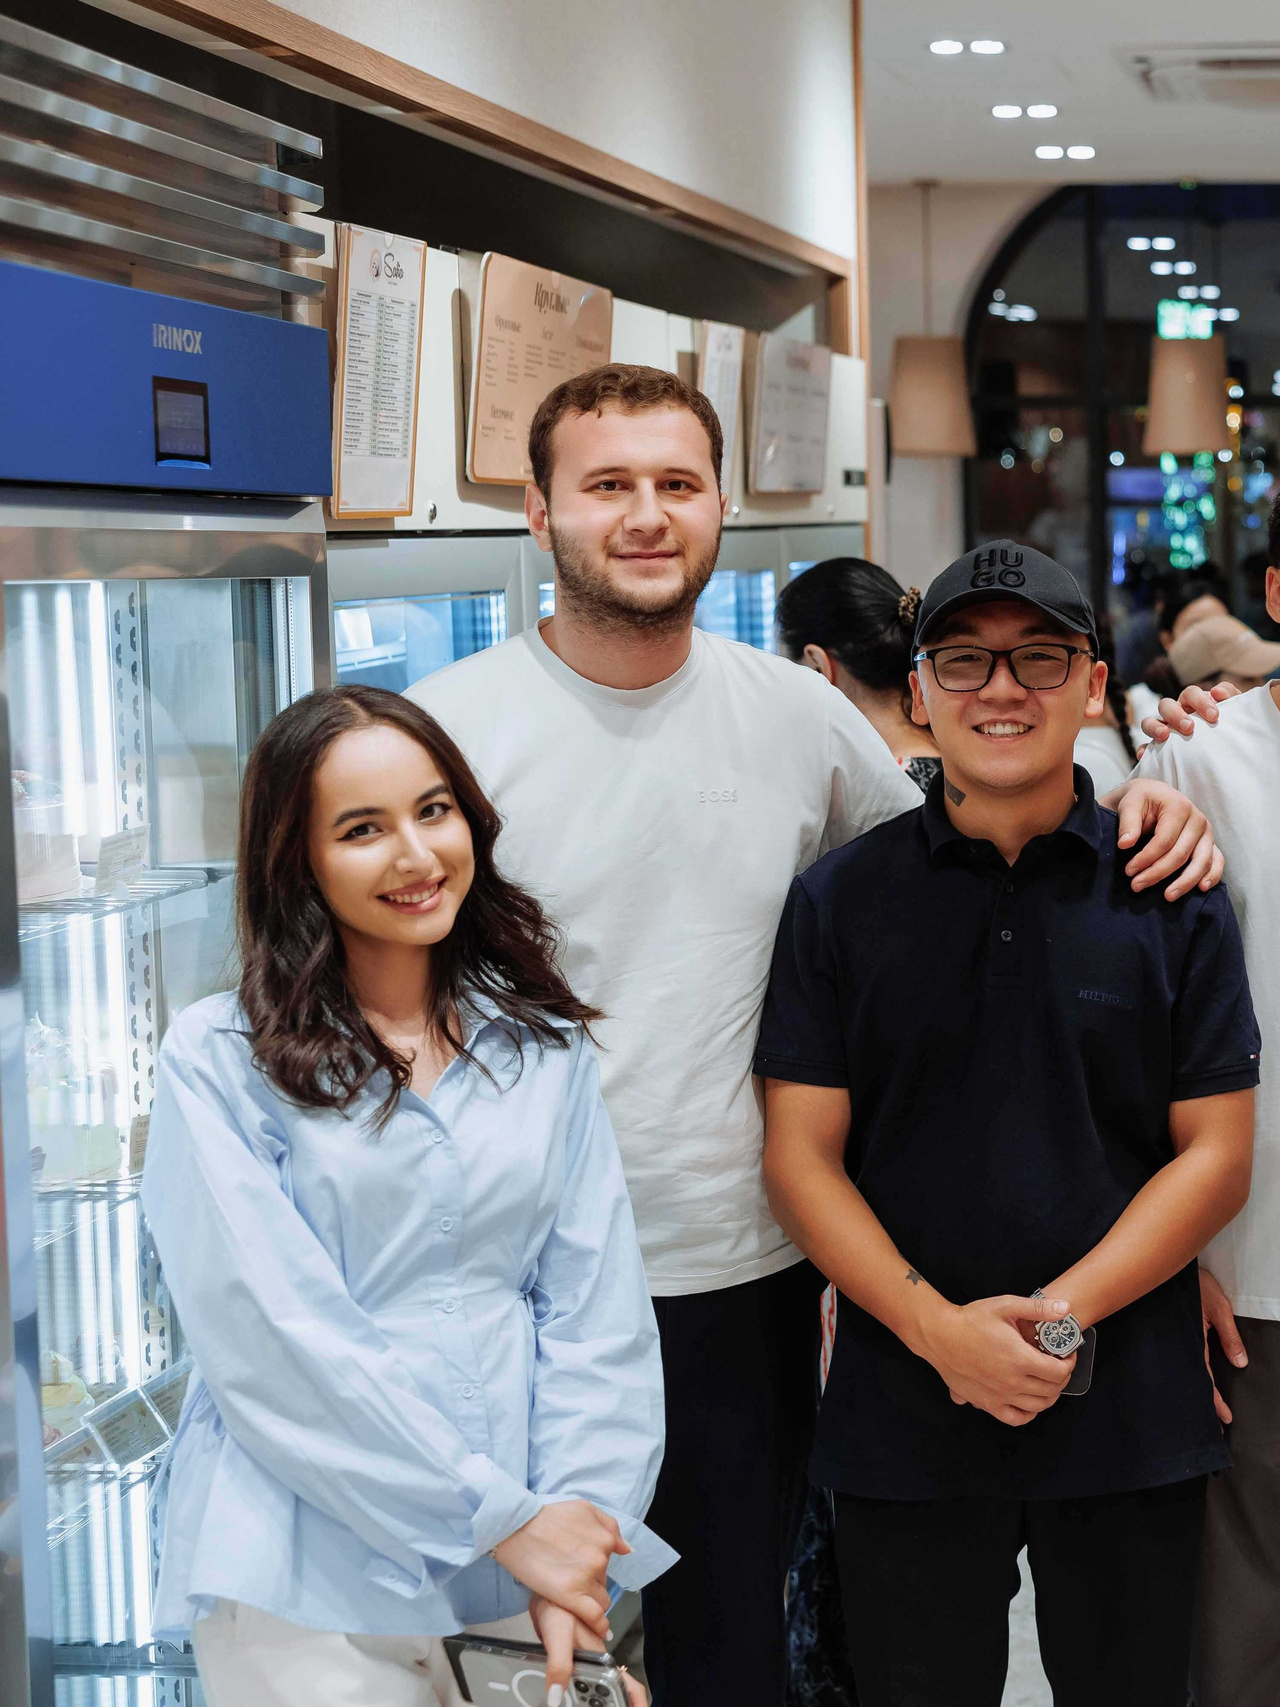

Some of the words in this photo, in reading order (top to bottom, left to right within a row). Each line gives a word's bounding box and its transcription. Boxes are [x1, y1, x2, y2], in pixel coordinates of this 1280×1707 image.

[152, 323, 203, 354] IRINOX
[973, 548, 1024, 571] HU
[970, 567, 1026, 589] GO
[697, 788, 738, 803] BOSS
